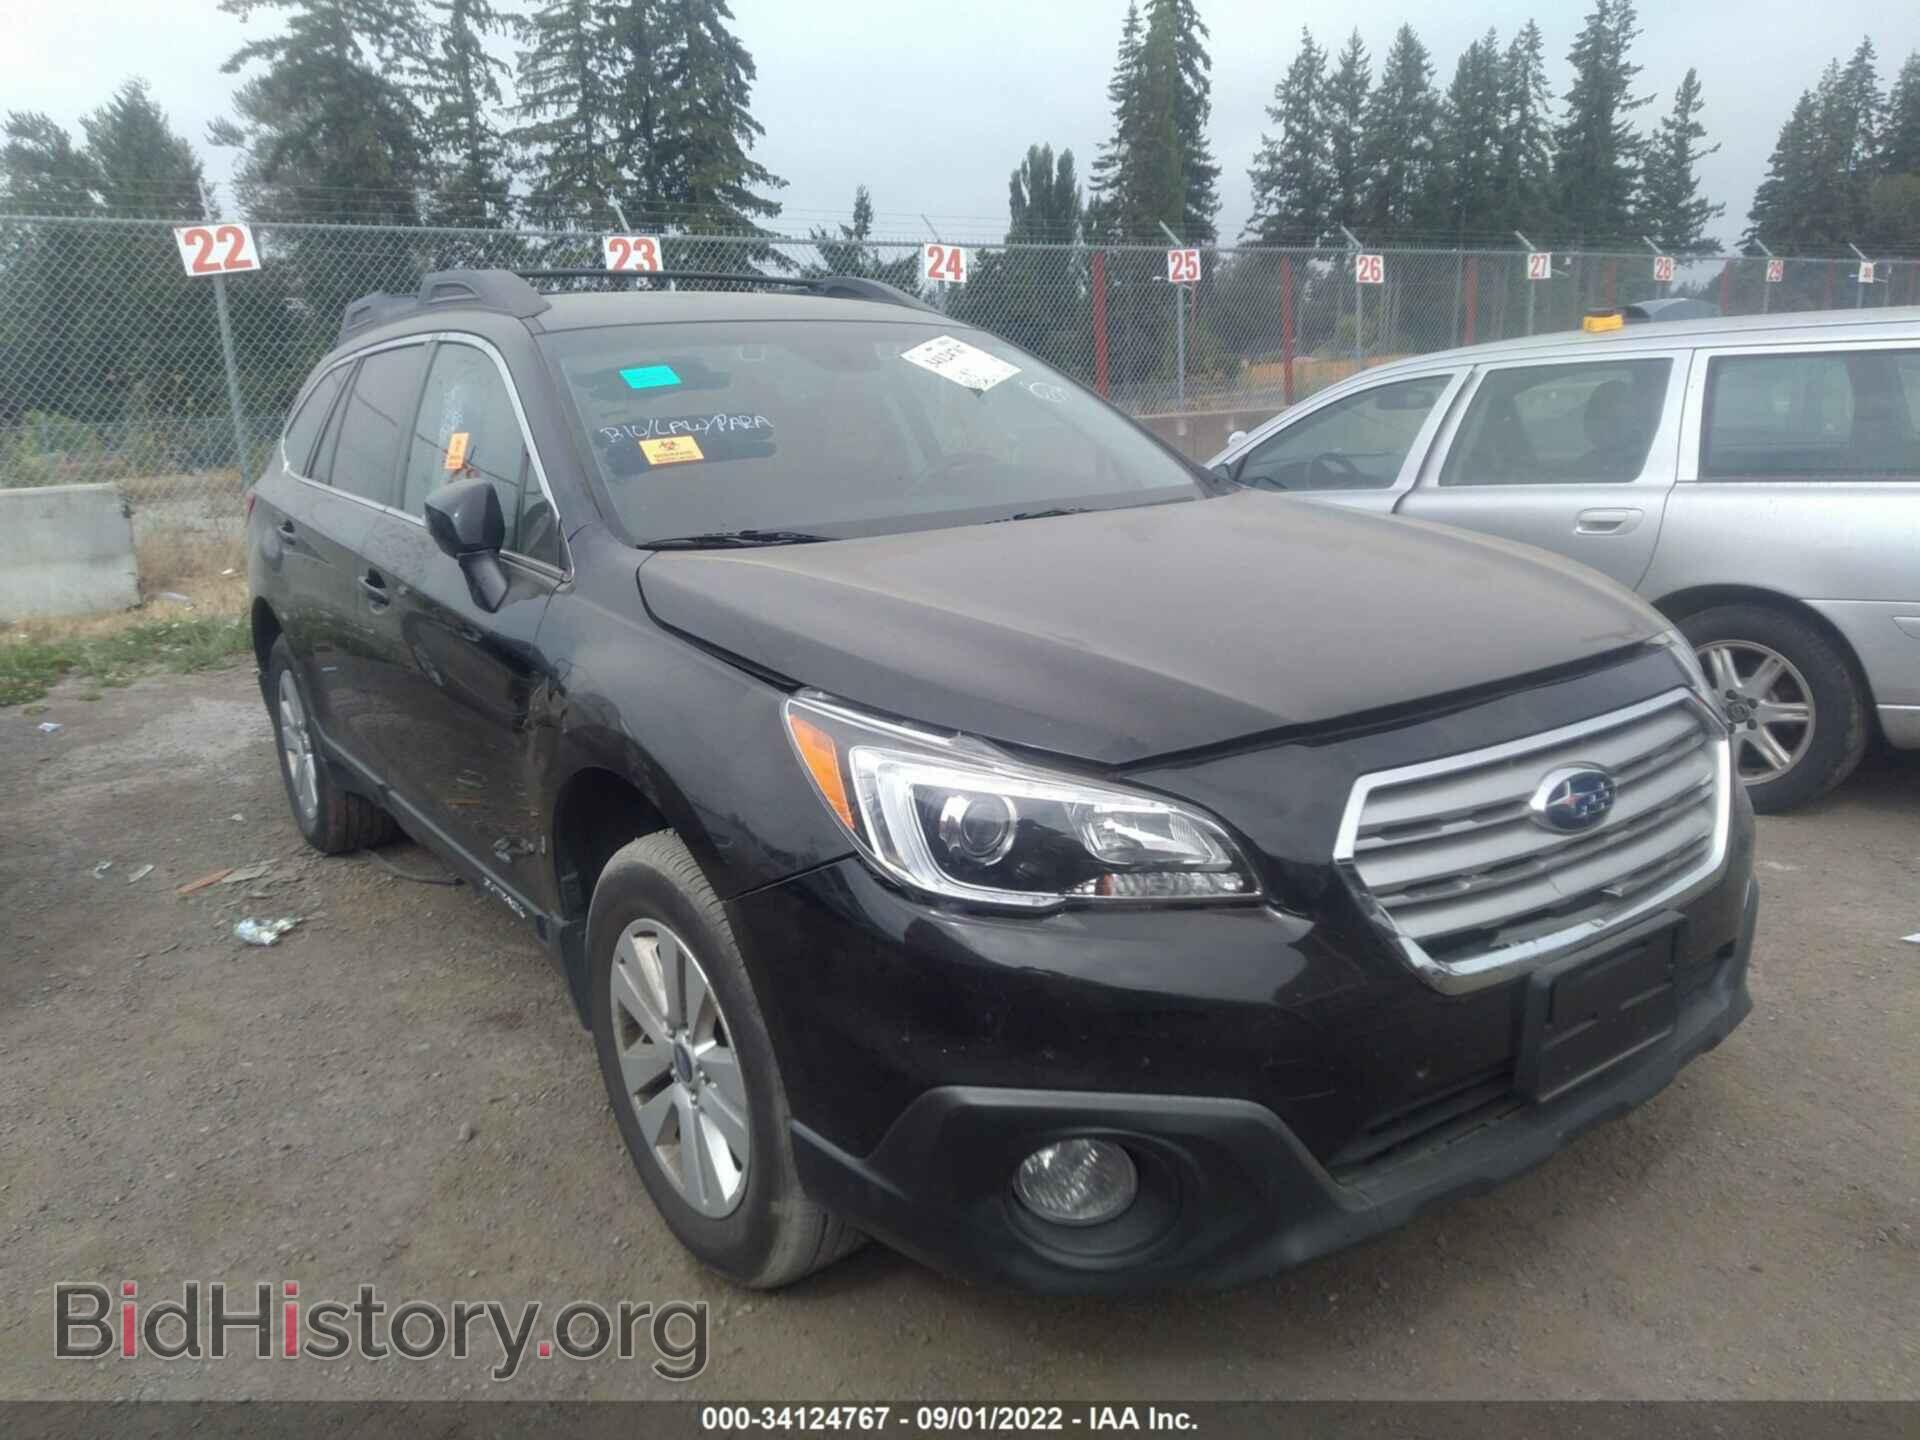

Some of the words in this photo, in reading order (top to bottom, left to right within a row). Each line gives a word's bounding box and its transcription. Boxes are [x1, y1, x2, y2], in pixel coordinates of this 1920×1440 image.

[184, 225, 253, 273] 22
[608, 238, 658, 272] 23
[927, 245, 964, 281] 24
[1170, 250, 1198, 281] 25
[1359, 256, 1382, 282] 26
[1530, 254, 1548, 278] 27
[1656, 258, 1672, 280] 28
